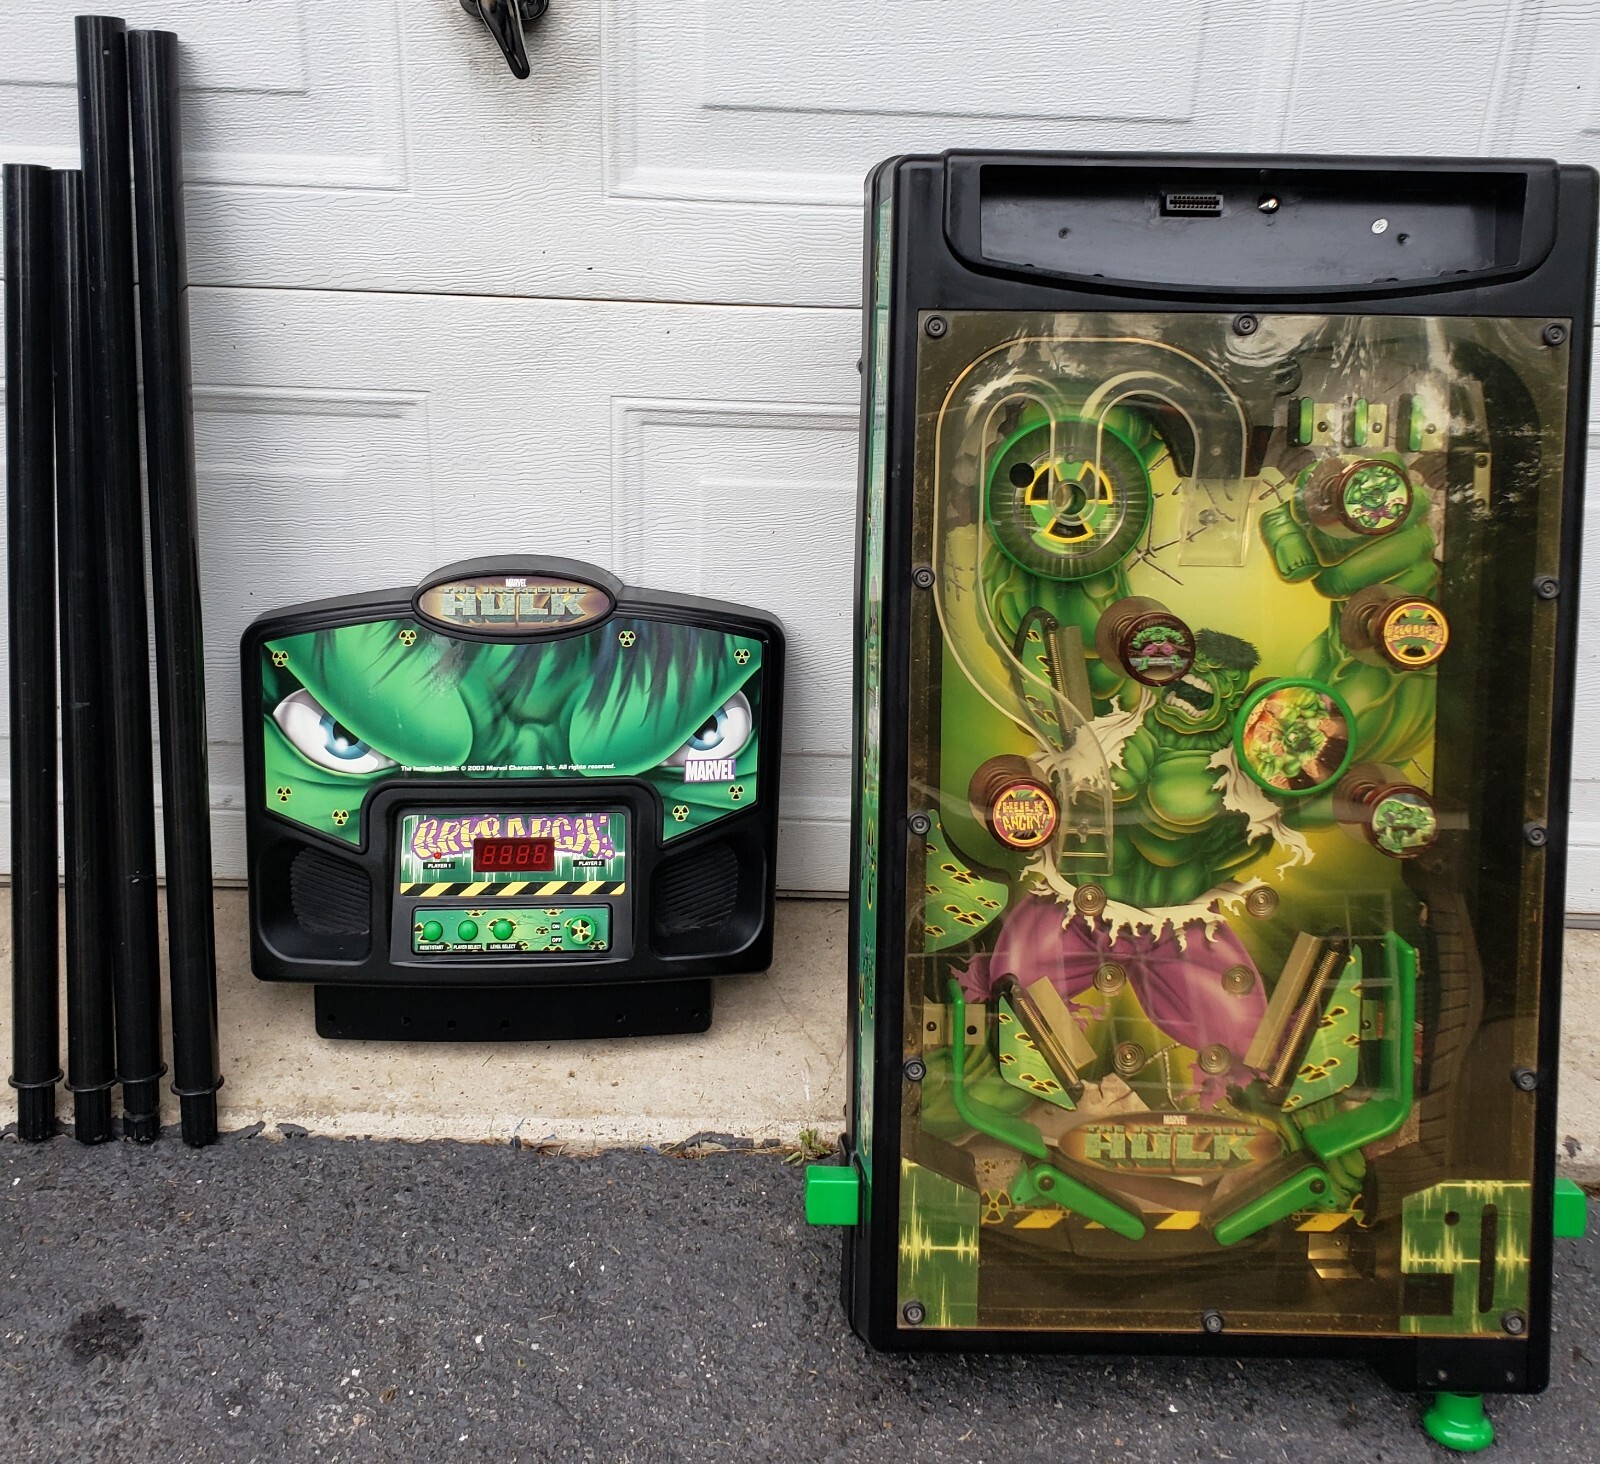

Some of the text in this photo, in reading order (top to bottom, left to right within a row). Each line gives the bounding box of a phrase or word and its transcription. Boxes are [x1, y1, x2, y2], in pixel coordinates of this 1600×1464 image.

[506, 578, 526, 587] MARVEL
[442, 594, 586, 616] HULK
[685, 759, 735, 781] MARVEL
[1002, 801, 1044, 813] HULK
[1002, 813, 1047, 831] ANGRY!
[1163, 1115, 1187, 1125] MARVEL
[1085, 1134, 1256, 1160] HULK
